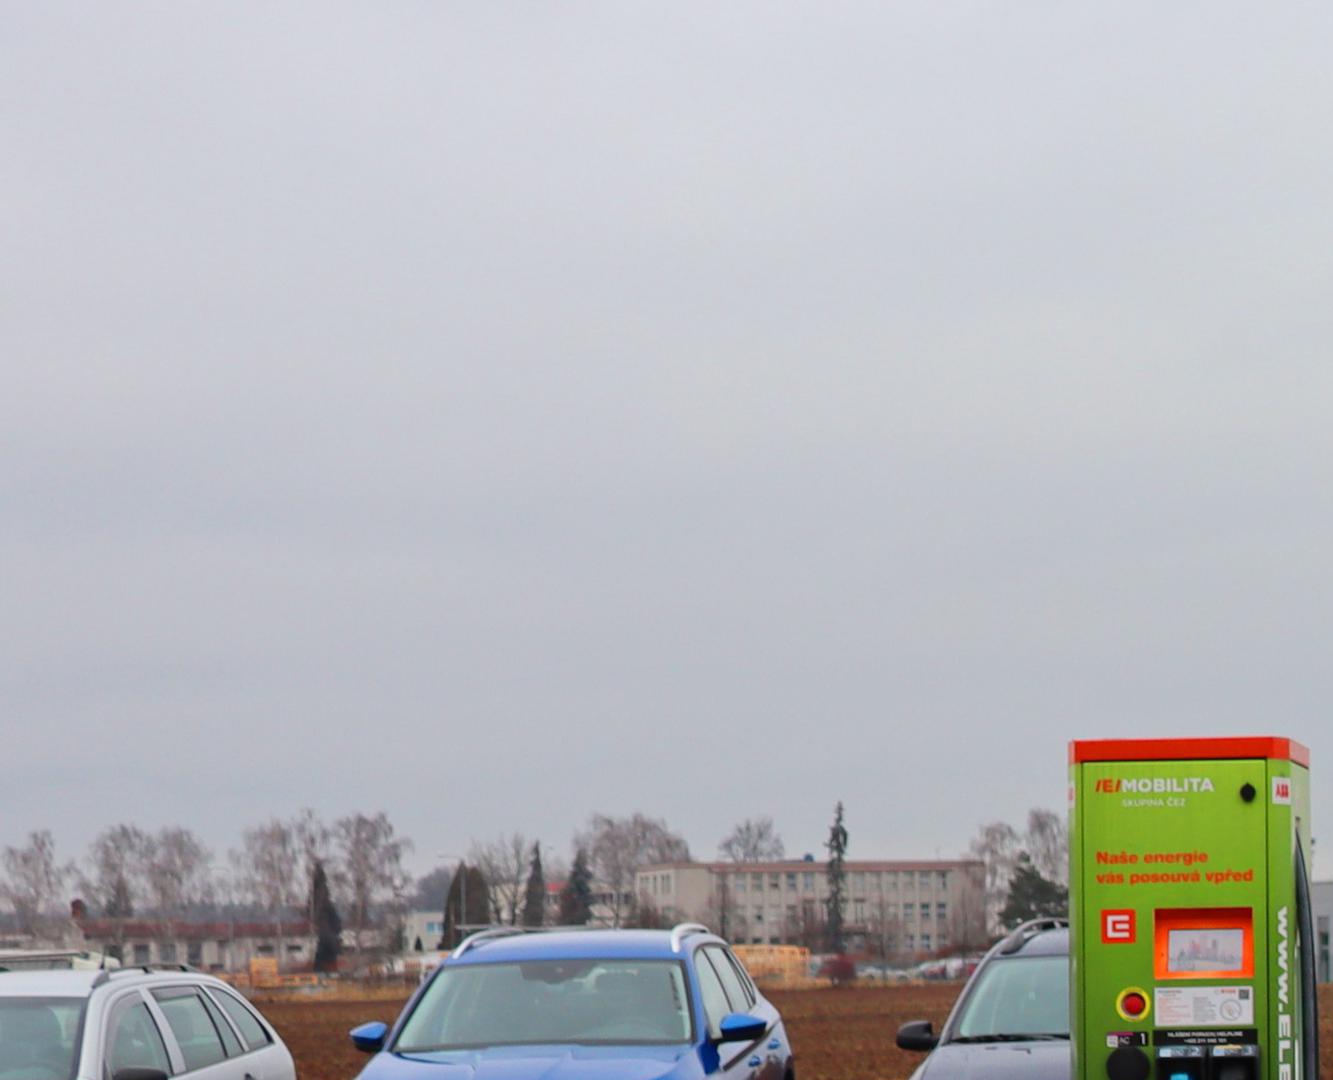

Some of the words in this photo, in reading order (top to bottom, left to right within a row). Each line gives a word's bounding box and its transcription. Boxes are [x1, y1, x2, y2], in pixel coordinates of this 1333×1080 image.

[1275, 783, 1289, 798] ABB
[1122, 799, 1165, 808] SKUPINA
[1167, 796, 1186, 808] ČEZ
[1096, 850, 1139, 865] Naše
[1143, 851, 1209, 866] energie
[1096, 871, 1125, 885] vás
[1129, 869, 1201, 886] posouvá
[1205, 869, 1254, 885] vpřed
[1141, 1033, 1146, 1045] 1
